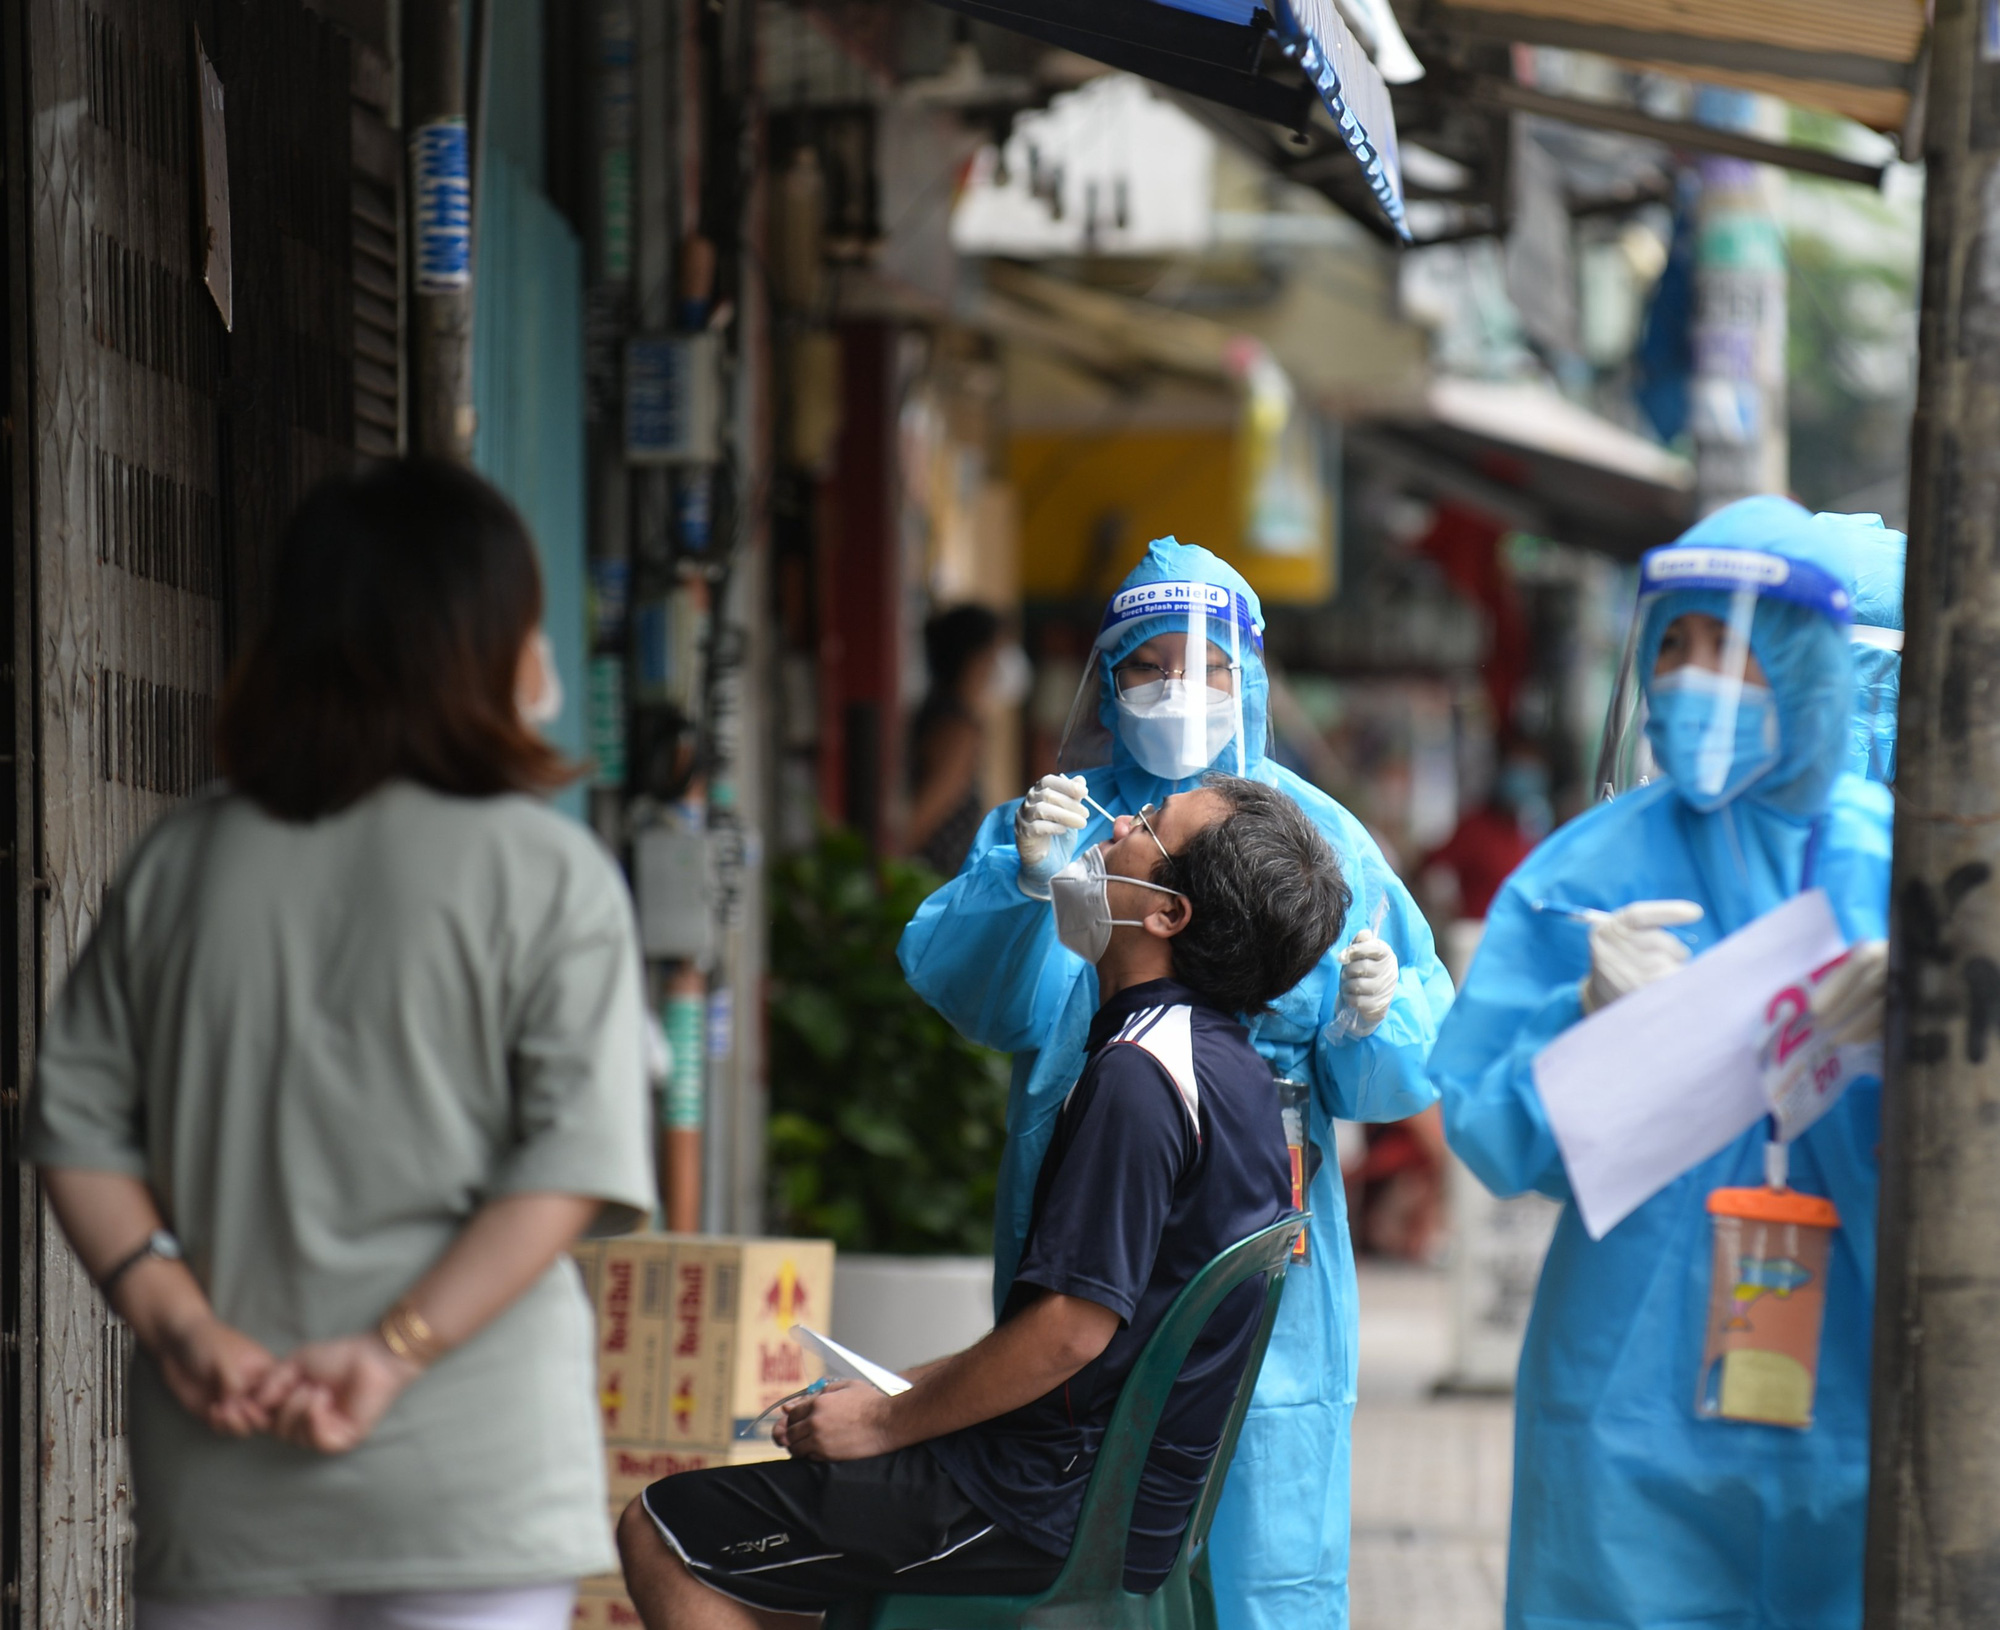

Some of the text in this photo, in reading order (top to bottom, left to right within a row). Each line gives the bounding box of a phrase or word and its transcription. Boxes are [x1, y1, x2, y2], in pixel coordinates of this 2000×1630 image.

[1120, 586, 1218, 608] Face shield
[1121, 603, 1218, 619] Direct Splash protection
